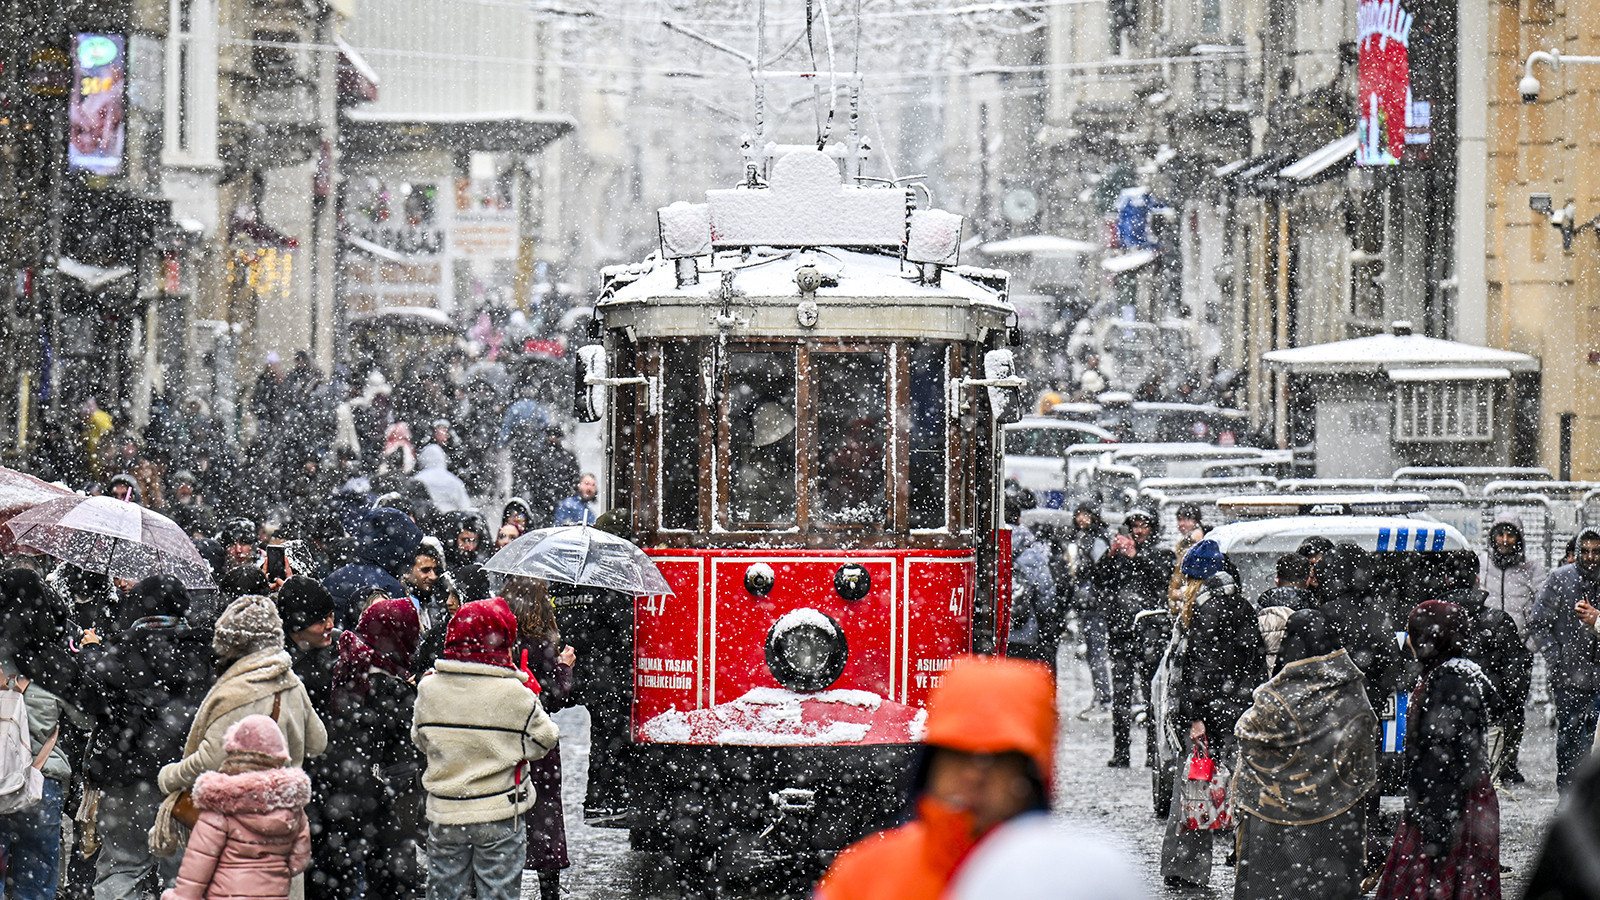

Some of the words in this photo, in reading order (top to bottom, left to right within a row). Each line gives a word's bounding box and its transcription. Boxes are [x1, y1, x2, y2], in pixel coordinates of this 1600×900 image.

[949, 587, 964, 616] 47
[664, 659, 693, 672] YASAK
[644, 674, 692, 690] TEHLİKELİDİR
[915, 675, 928, 688] VE
